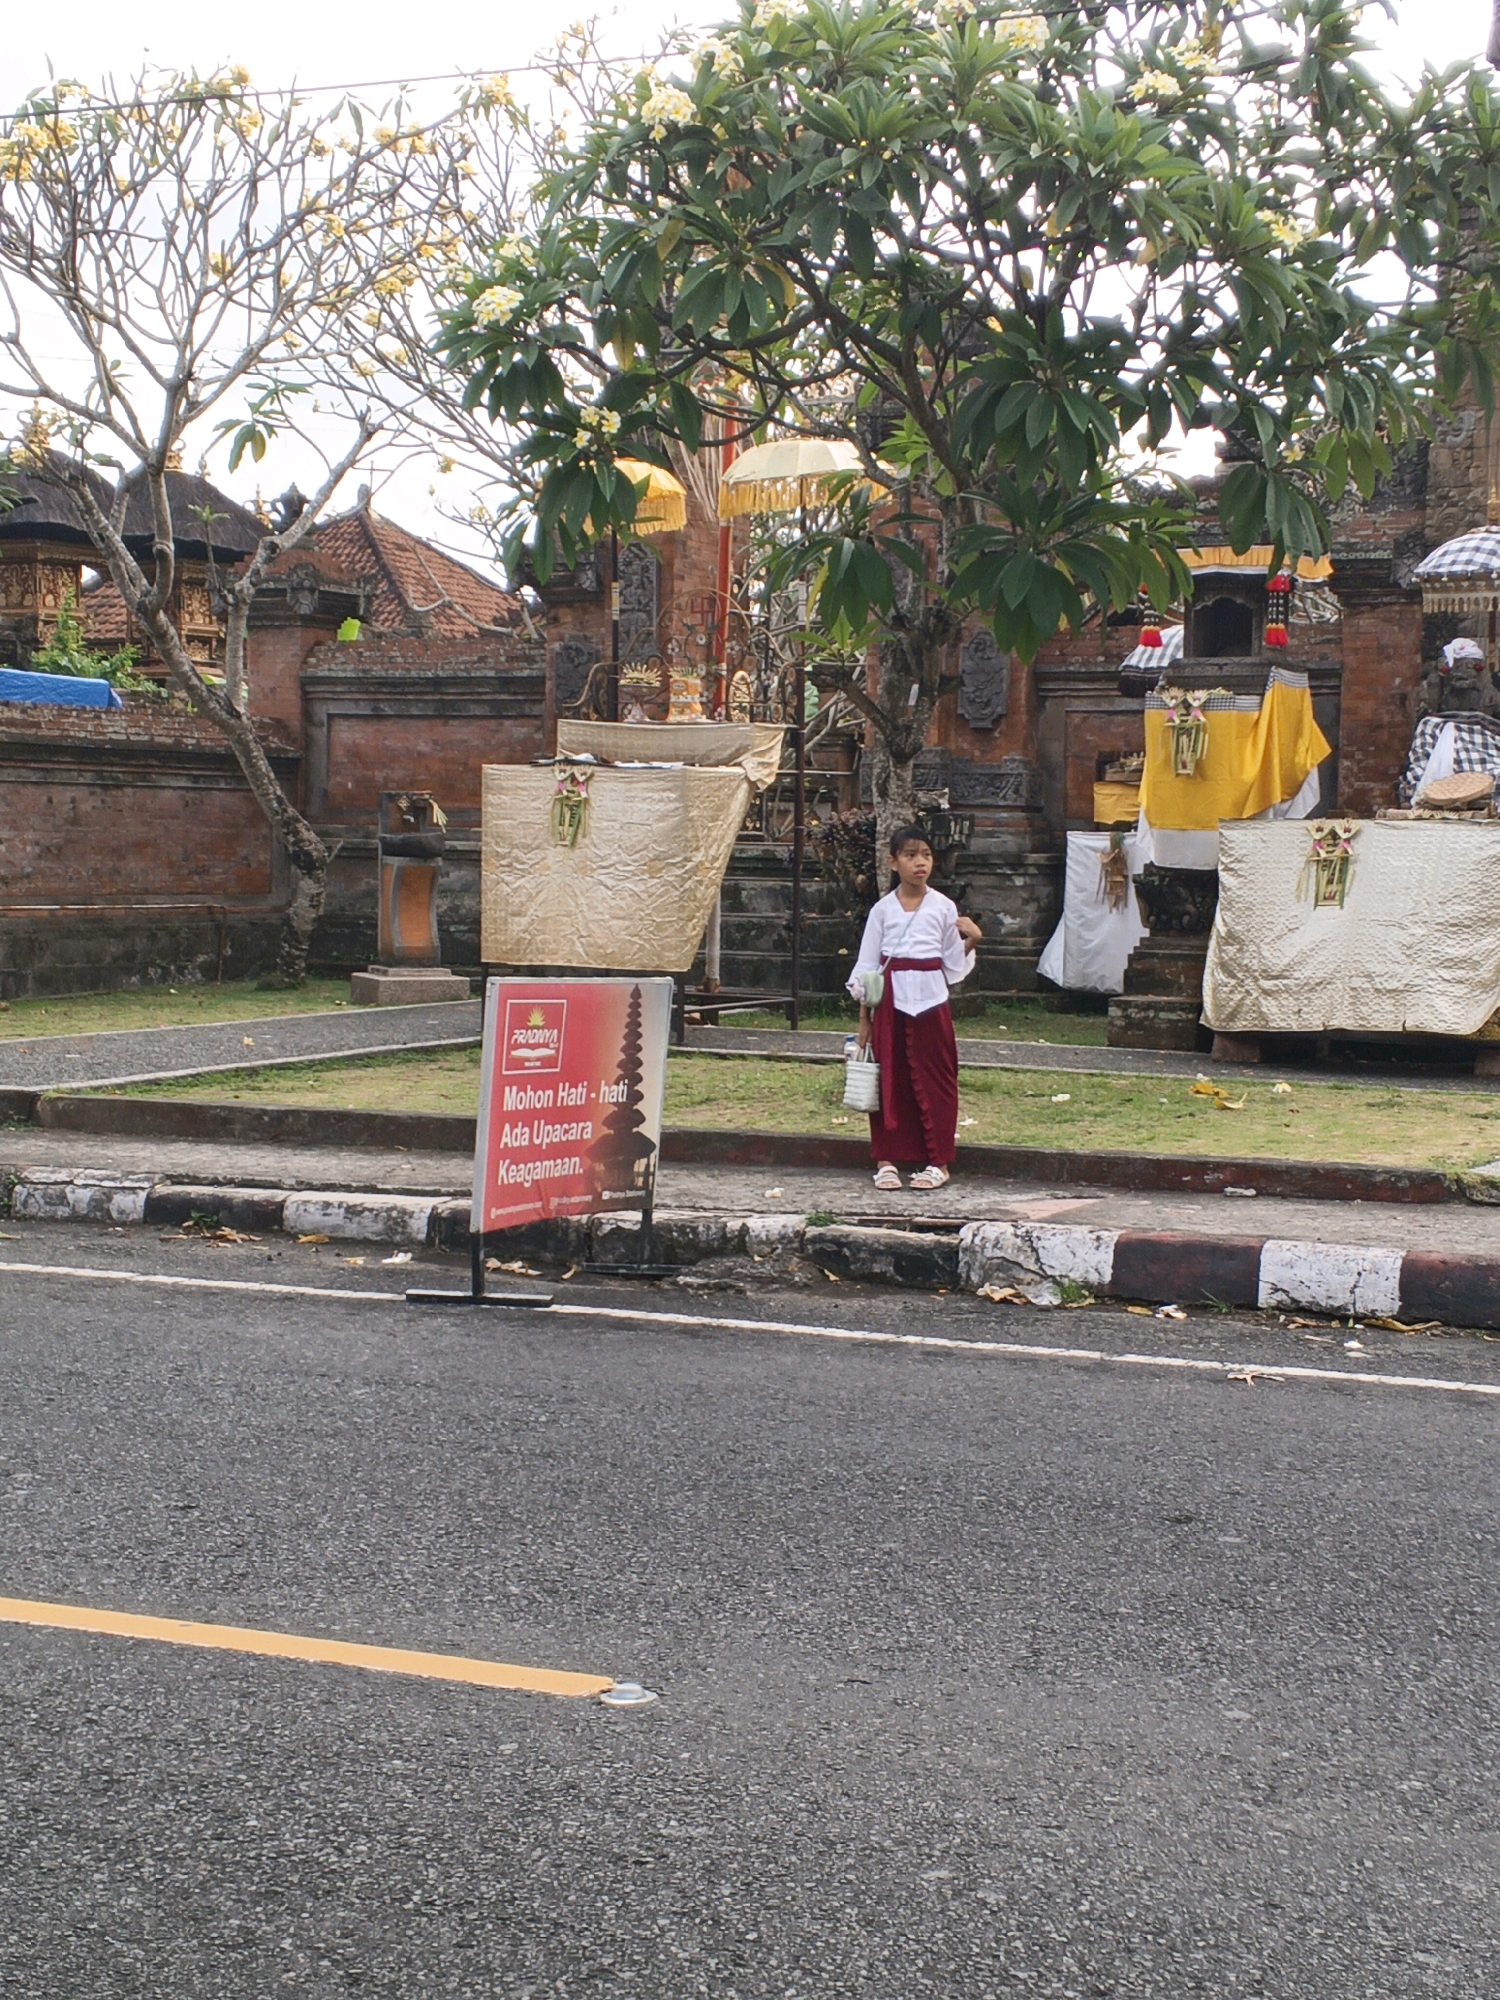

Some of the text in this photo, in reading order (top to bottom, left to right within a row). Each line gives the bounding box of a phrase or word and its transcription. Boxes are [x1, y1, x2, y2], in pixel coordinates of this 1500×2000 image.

[503, 1084, 553, 1111] Mohon
[557, 1081, 587, 1106] Hati
[599, 1079, 628, 1103] hati
[500, 1119, 592, 1150] Ada Upacara
[498, 1156, 583, 1187] Keagamaan.
